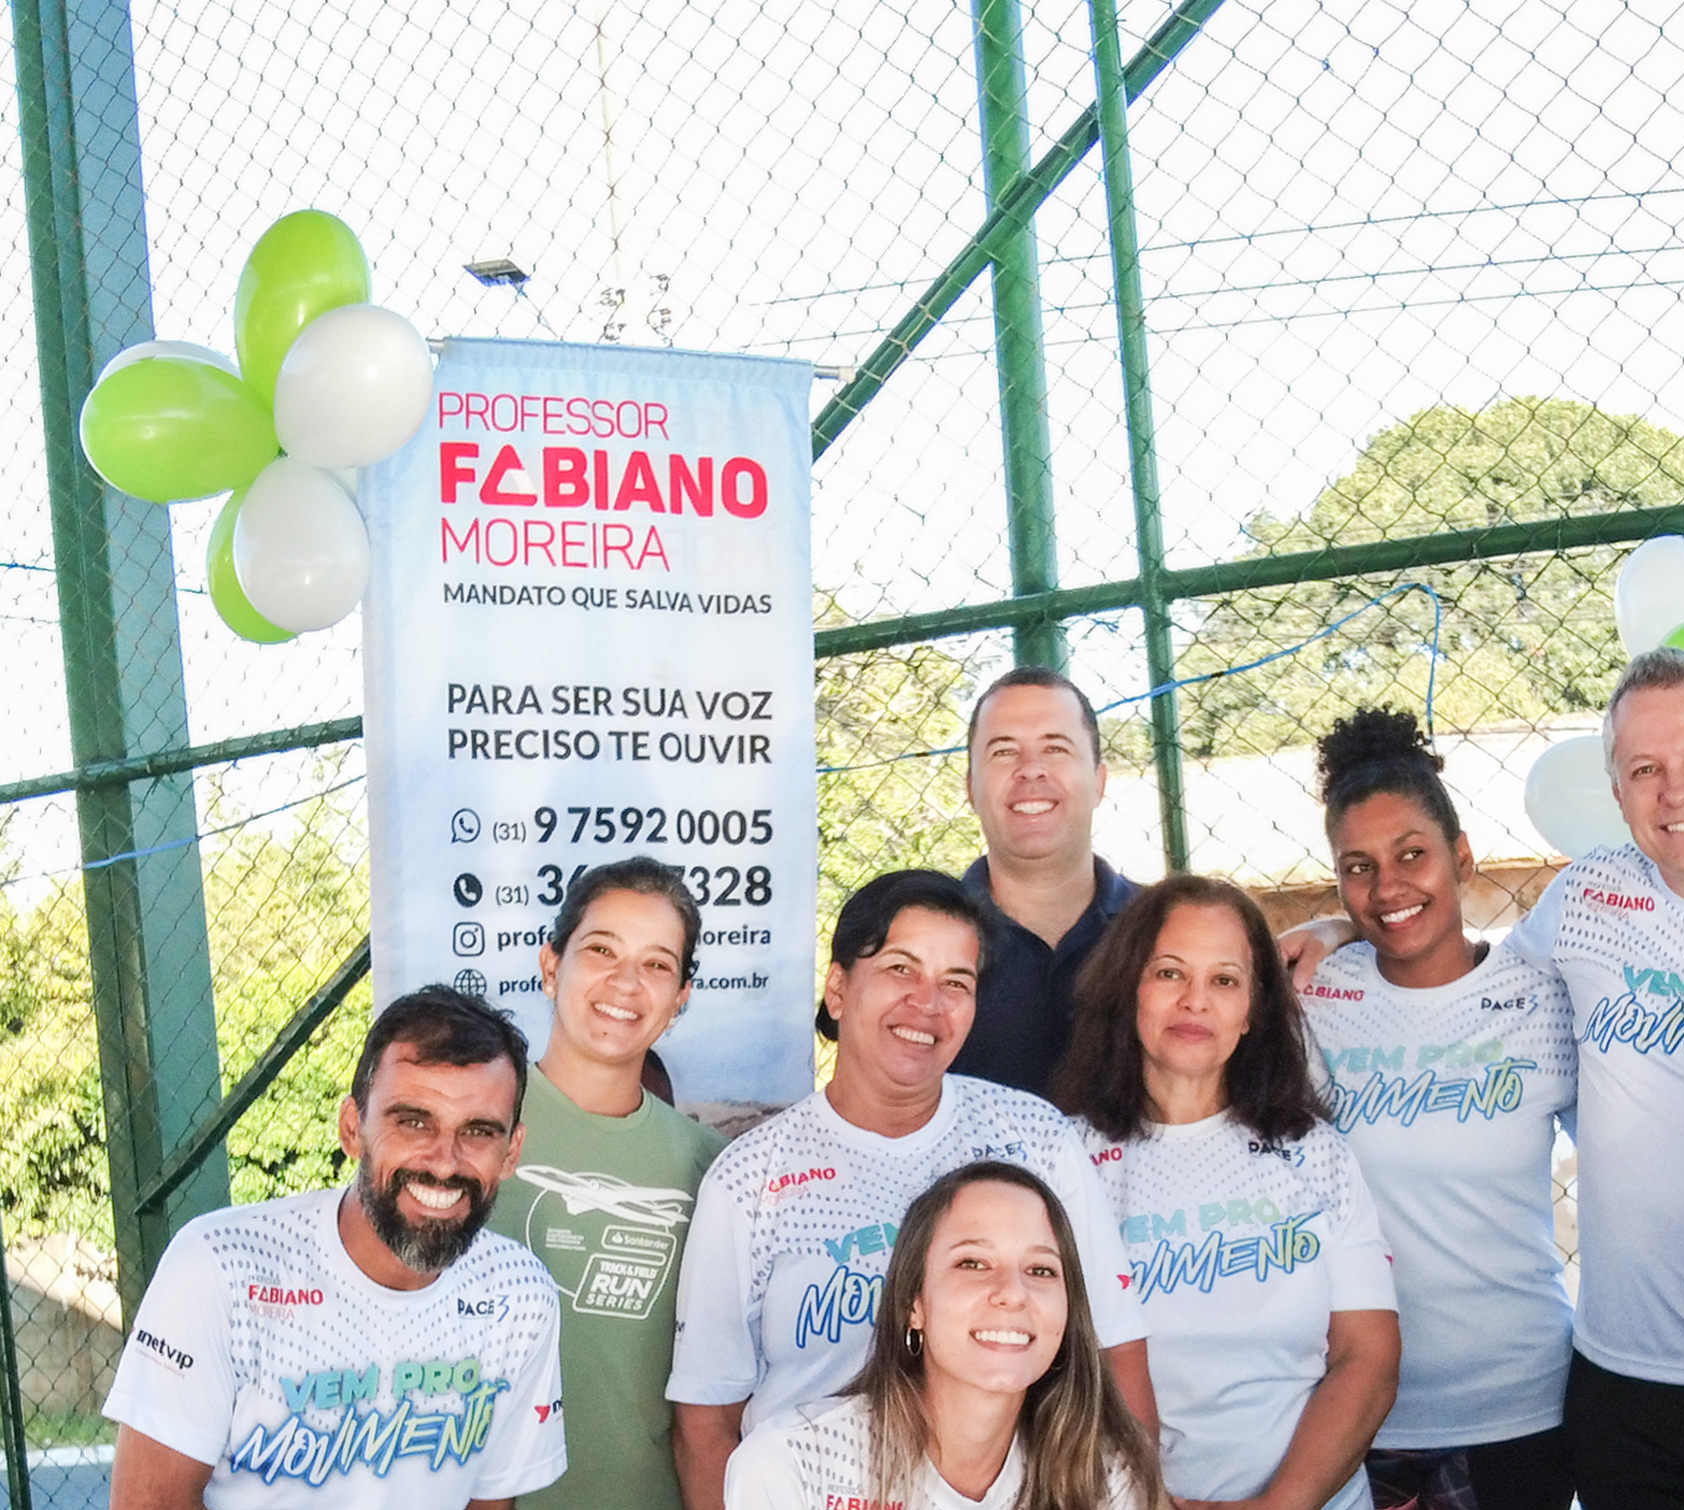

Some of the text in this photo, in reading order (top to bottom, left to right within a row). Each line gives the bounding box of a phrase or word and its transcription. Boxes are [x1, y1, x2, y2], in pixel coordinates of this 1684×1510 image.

[438, 392, 670, 440] PROFESSOR
[439, 441, 769, 519] FABIANO
[441, 518, 671, 572] MOREIRA
[444, 582, 772, 616] MANDATO QUE SALVA VIDAS
[448, 683, 773, 722] PARA SER SUA VOZ
[448, 728, 772, 766] PRECISO TE OUVIR
[492, 808, 774, 844] (31) 9 7592 0005
[495, 882, 530, 907] (31)
[1582, 887, 1656, 913] FABIANO
[1325, 1038, 1505, 1075] VEM PRO
[1199, 1196, 1281, 1233] PRO
[624, 1232, 671, 1249] Santander
[248, 1284, 324, 1306] FABIANO
[586, 1293, 643, 1311] SERIES
[590, 1273, 653, 1299] RUN
[281, 1357, 481, 1411] VEM PRO
[231, 1377, 512, 1488] MOVIMENTO
